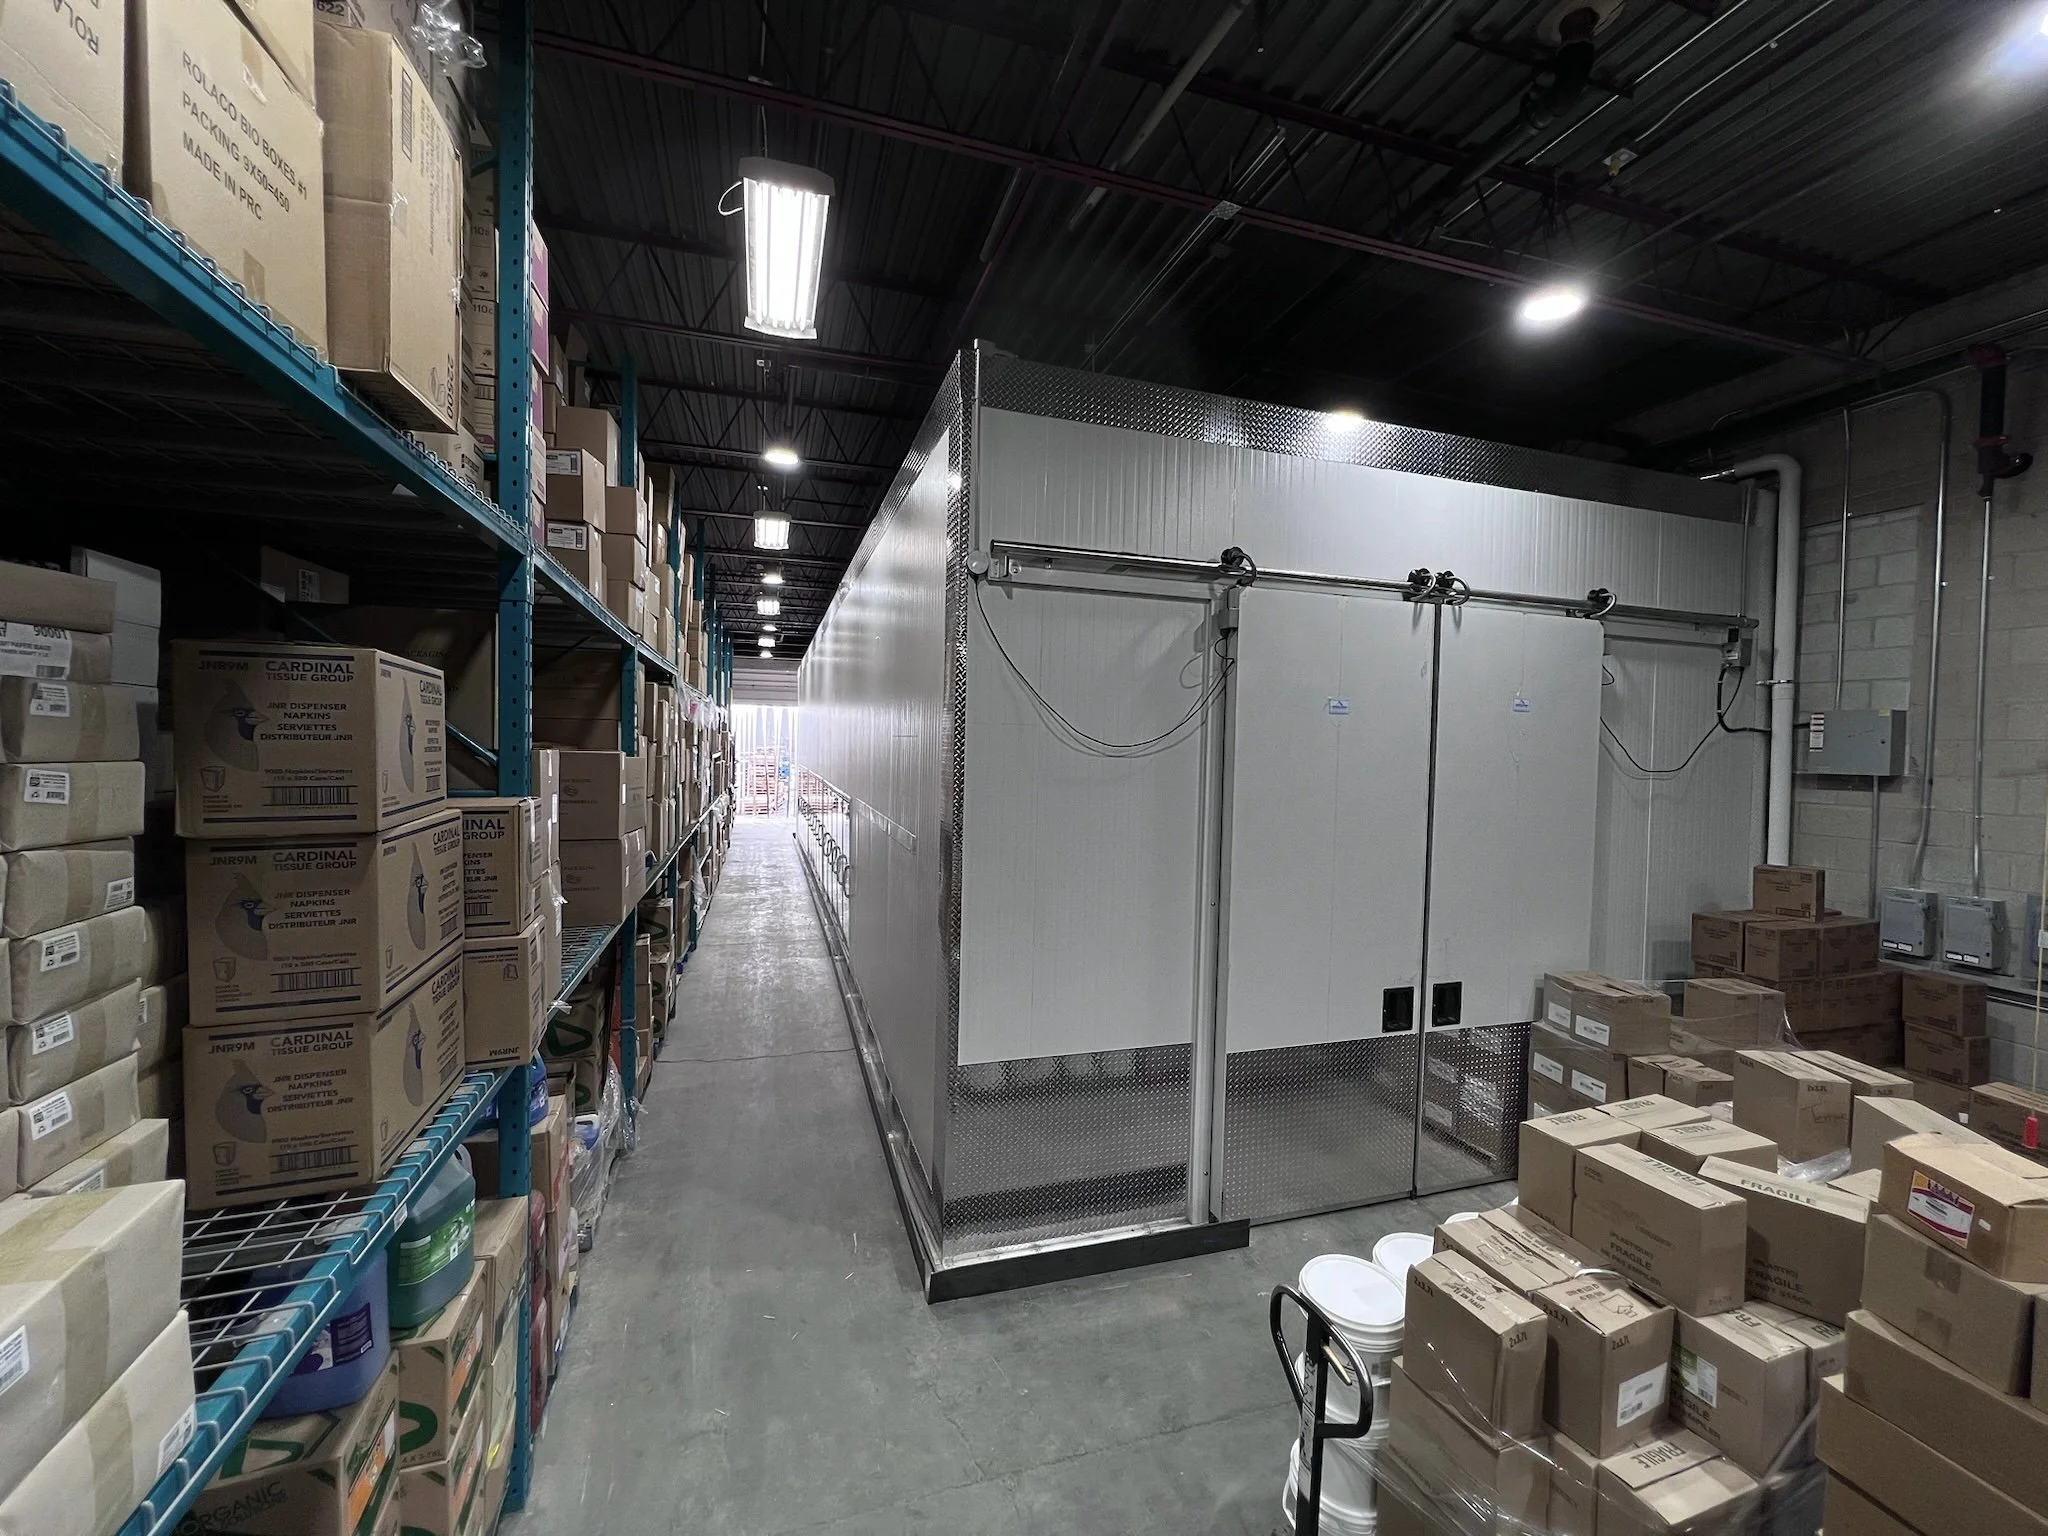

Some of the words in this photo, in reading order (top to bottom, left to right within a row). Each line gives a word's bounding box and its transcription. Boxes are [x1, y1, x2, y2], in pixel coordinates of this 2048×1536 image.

[182, 51, 237, 121] ROLACO
[240, 113, 260, 146] BIO
[262, 138, 297, 186] BOXES
[182, 91, 239, 161] PACKING
[243, 155, 290, 213] 9X50=450
[182, 131, 221, 182] MADE
[224, 170, 236, 195] IN
[239, 185, 263, 220] PRC
[198, 660, 249, 671] JNR9M
[265, 661, 354, 674] CARDINAL
[266, 672, 307, 682] TISSUE
[311, 673, 354, 682] GROUP
[290, 702, 347, 710] DISPENSER
[284, 712, 331, 720] NAPKINS
[260, 733, 331, 741] DISTRIBUTEUR
[462, 818, 505, 830] INAL
[433, 826, 460, 845] CARDINAL
[209, 855, 257, 866] JNR9M
[272, 850, 357, 863] CARDINAL
[273, 862, 313, 871] TISSUE
[315, 861, 357, 870] GROUP
[295, 889, 350, 898] DISPENSER
[290, 900, 335, 908] NAPKINS
[284, 910, 341, 919] SERVIETTES
[268, 920, 336, 930] DISTRIBUTEUR
[338, 918, 357, 926] JNR
[432, 964, 460, 995] CARDINAL
[270, 1030, 354, 1047] CARDINAL
[208, 1042, 255, 1054] JNR9M
[271, 1046, 309, 1056] TISSUE
[313, 1041, 353, 1052] GROUP
[273, 1075, 291, 1083] JNR
[294, 1069, 347, 1080] DISPENSER
[288, 1079, 333, 1090] NAPKINS
[282, 1089, 338, 1102] SERVIETTES
[267, 1100, 334, 1113] DISTRIBUTEUR
[336, 1096, 354, 1106] JNR
[1641, 1158, 1705, 1187] FRAGILE
[1741, 1178, 1816, 1205] FRAGILE
[1610, 1241, 1652, 1271] FRAGILE
[1748, 1268, 1805, 1292] FRAGILE
[1630, 1441, 1687, 1469] FRAGILE
[181, 1480, 282, 1536] ORGANIC
